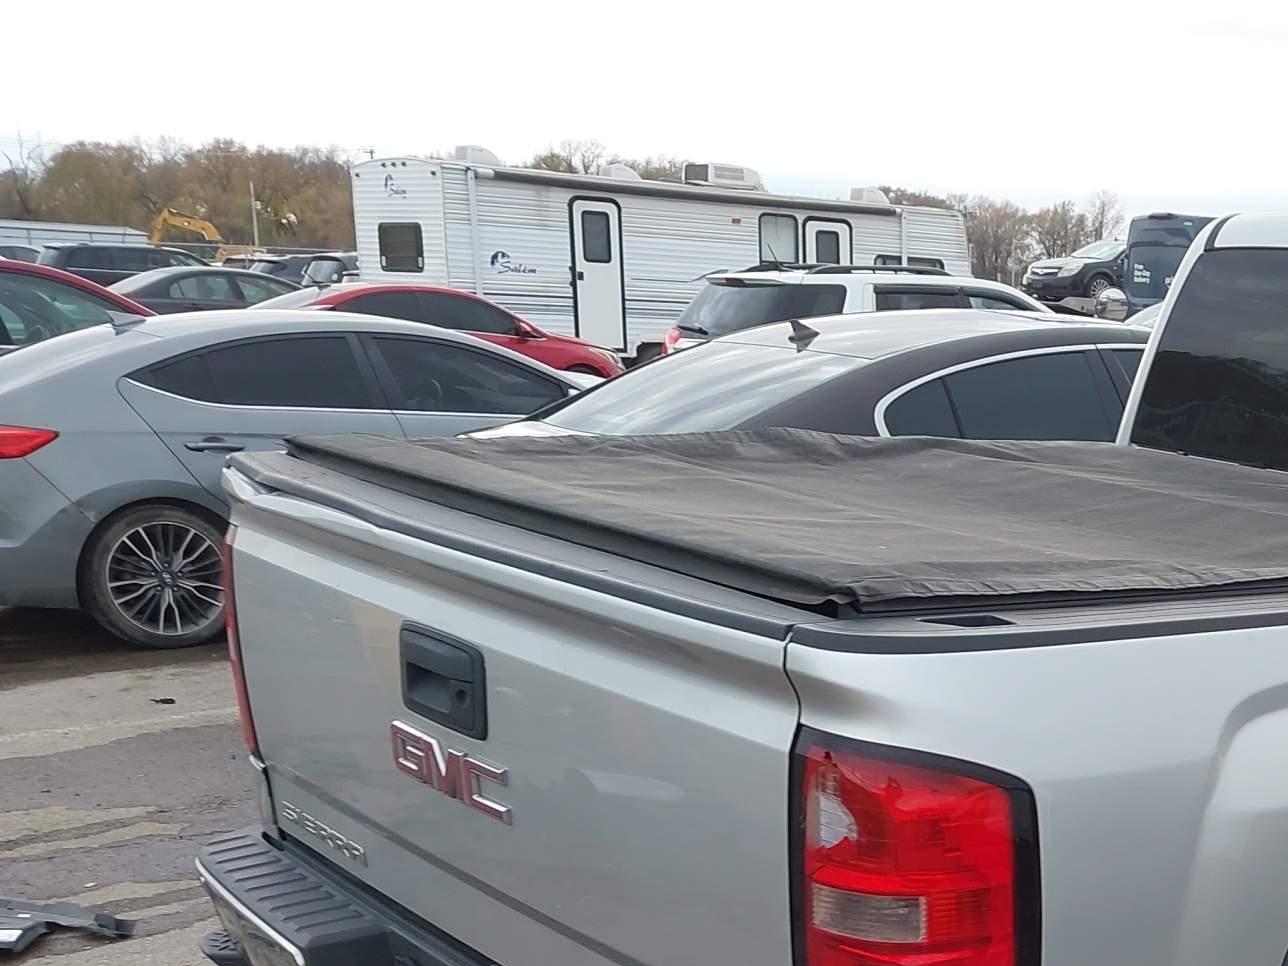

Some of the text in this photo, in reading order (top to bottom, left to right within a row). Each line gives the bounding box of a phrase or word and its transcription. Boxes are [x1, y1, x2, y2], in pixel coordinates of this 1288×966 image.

[497, 260, 537, 274] Salem
[391, 719, 513, 826] GMC
[281, 800, 368, 867] SIERRA
